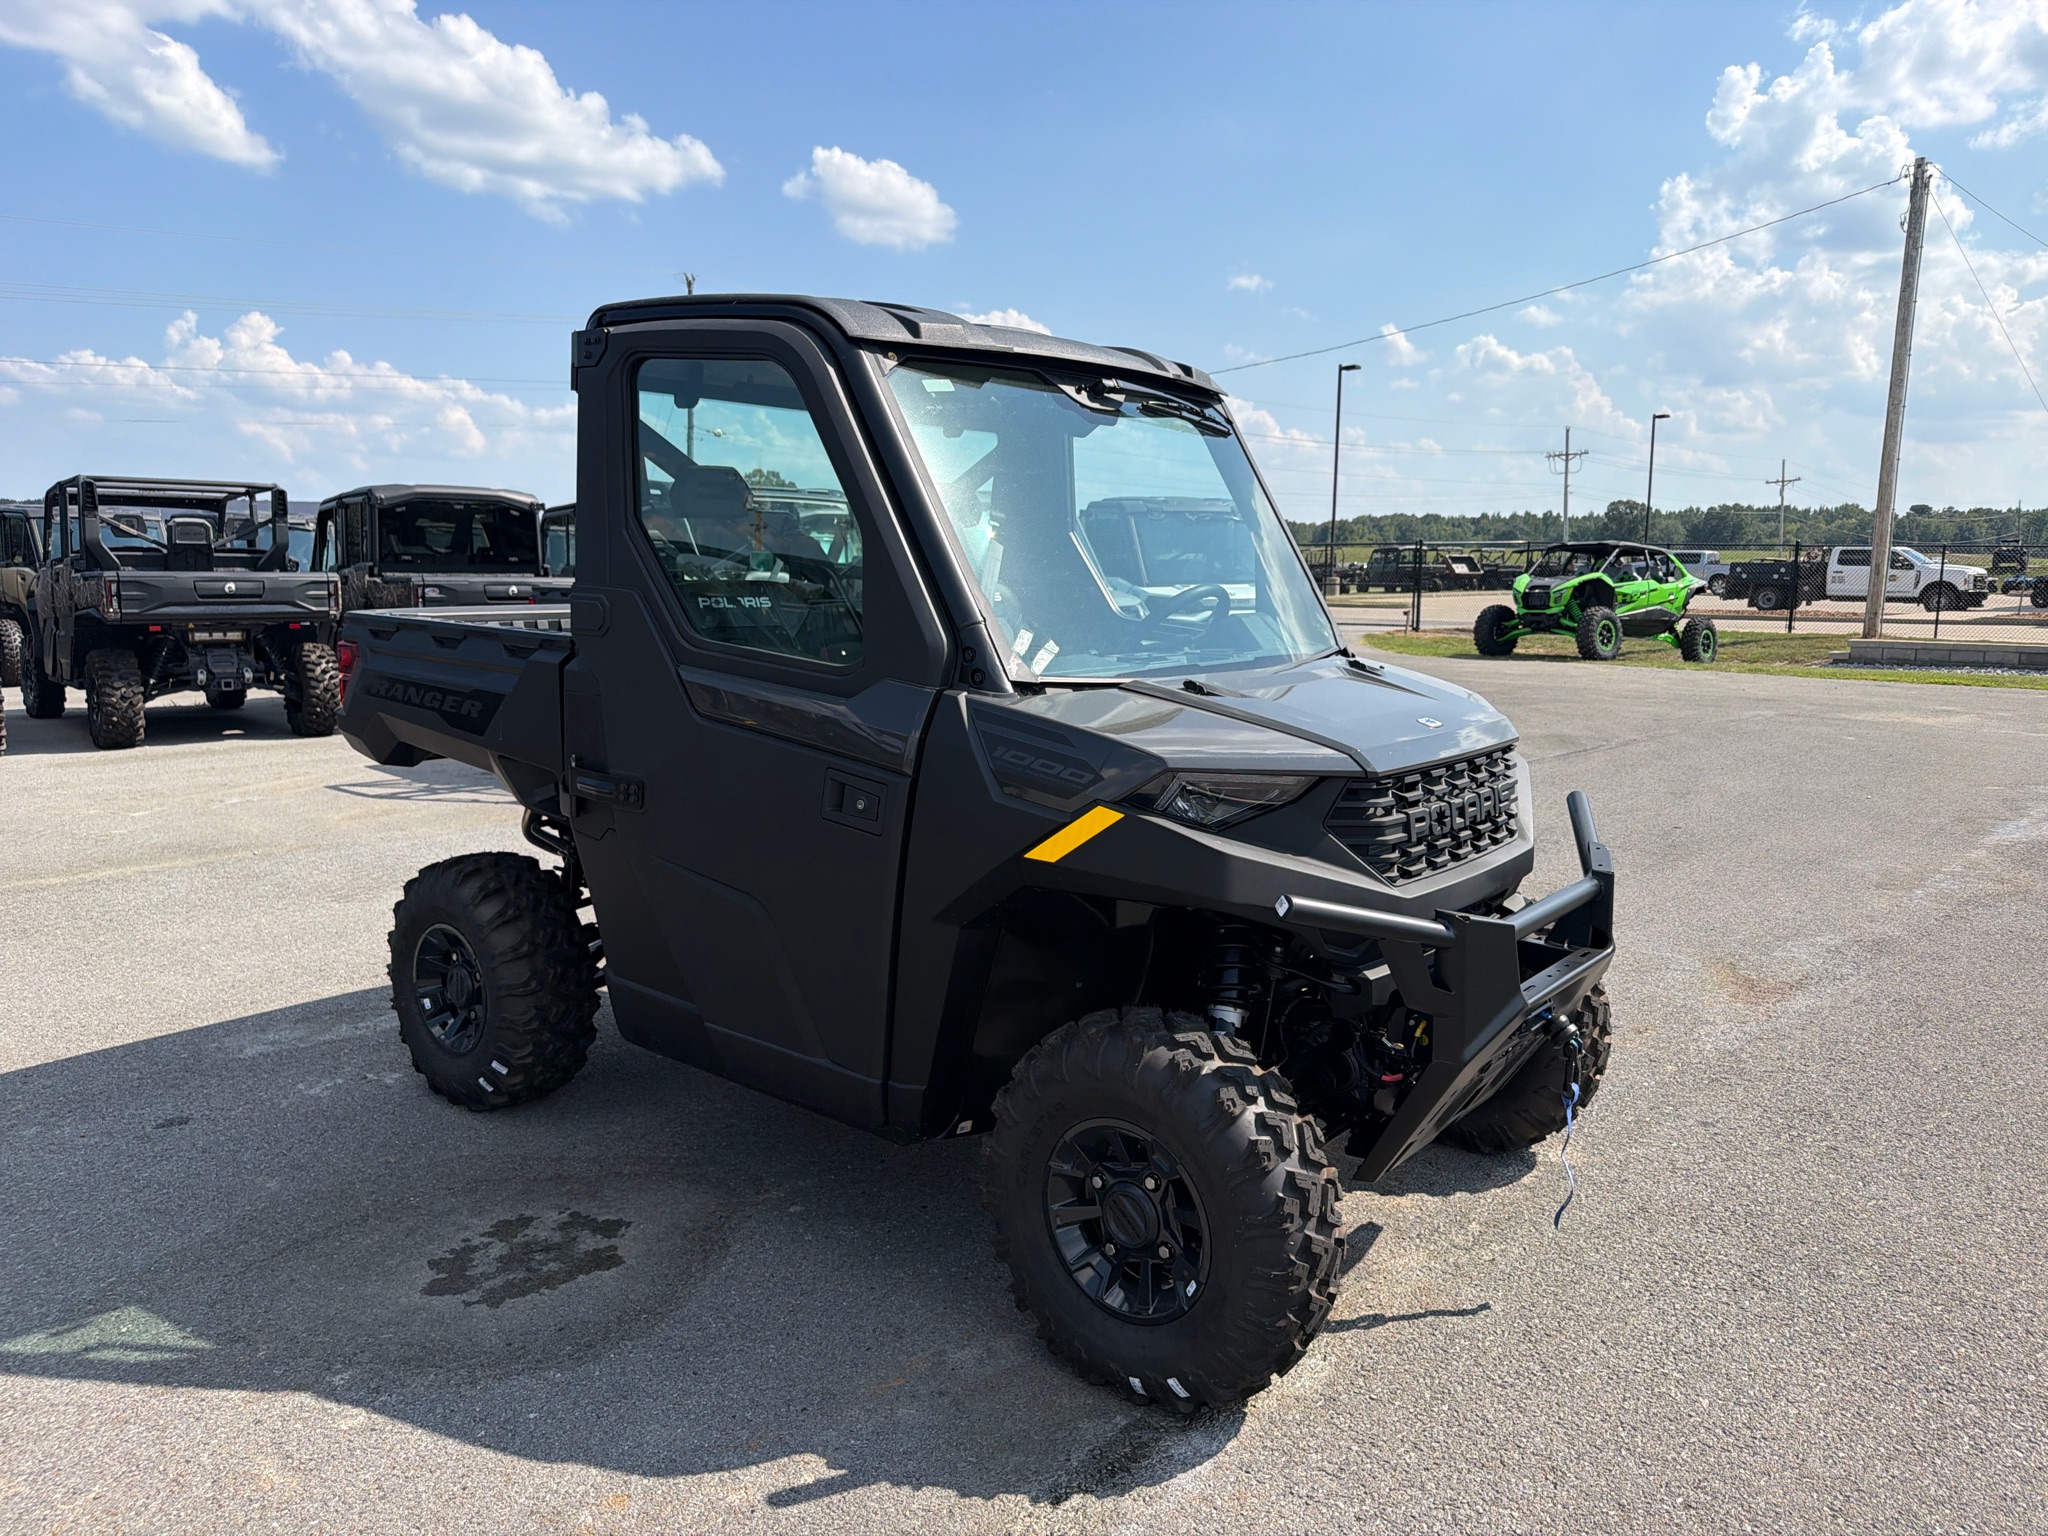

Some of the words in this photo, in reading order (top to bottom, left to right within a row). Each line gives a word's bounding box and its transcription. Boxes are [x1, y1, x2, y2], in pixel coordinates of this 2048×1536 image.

[370, 680, 483, 718] RANGER
[991, 745, 1095, 784] 1000
[1408, 779, 1518, 842] POLARIS
